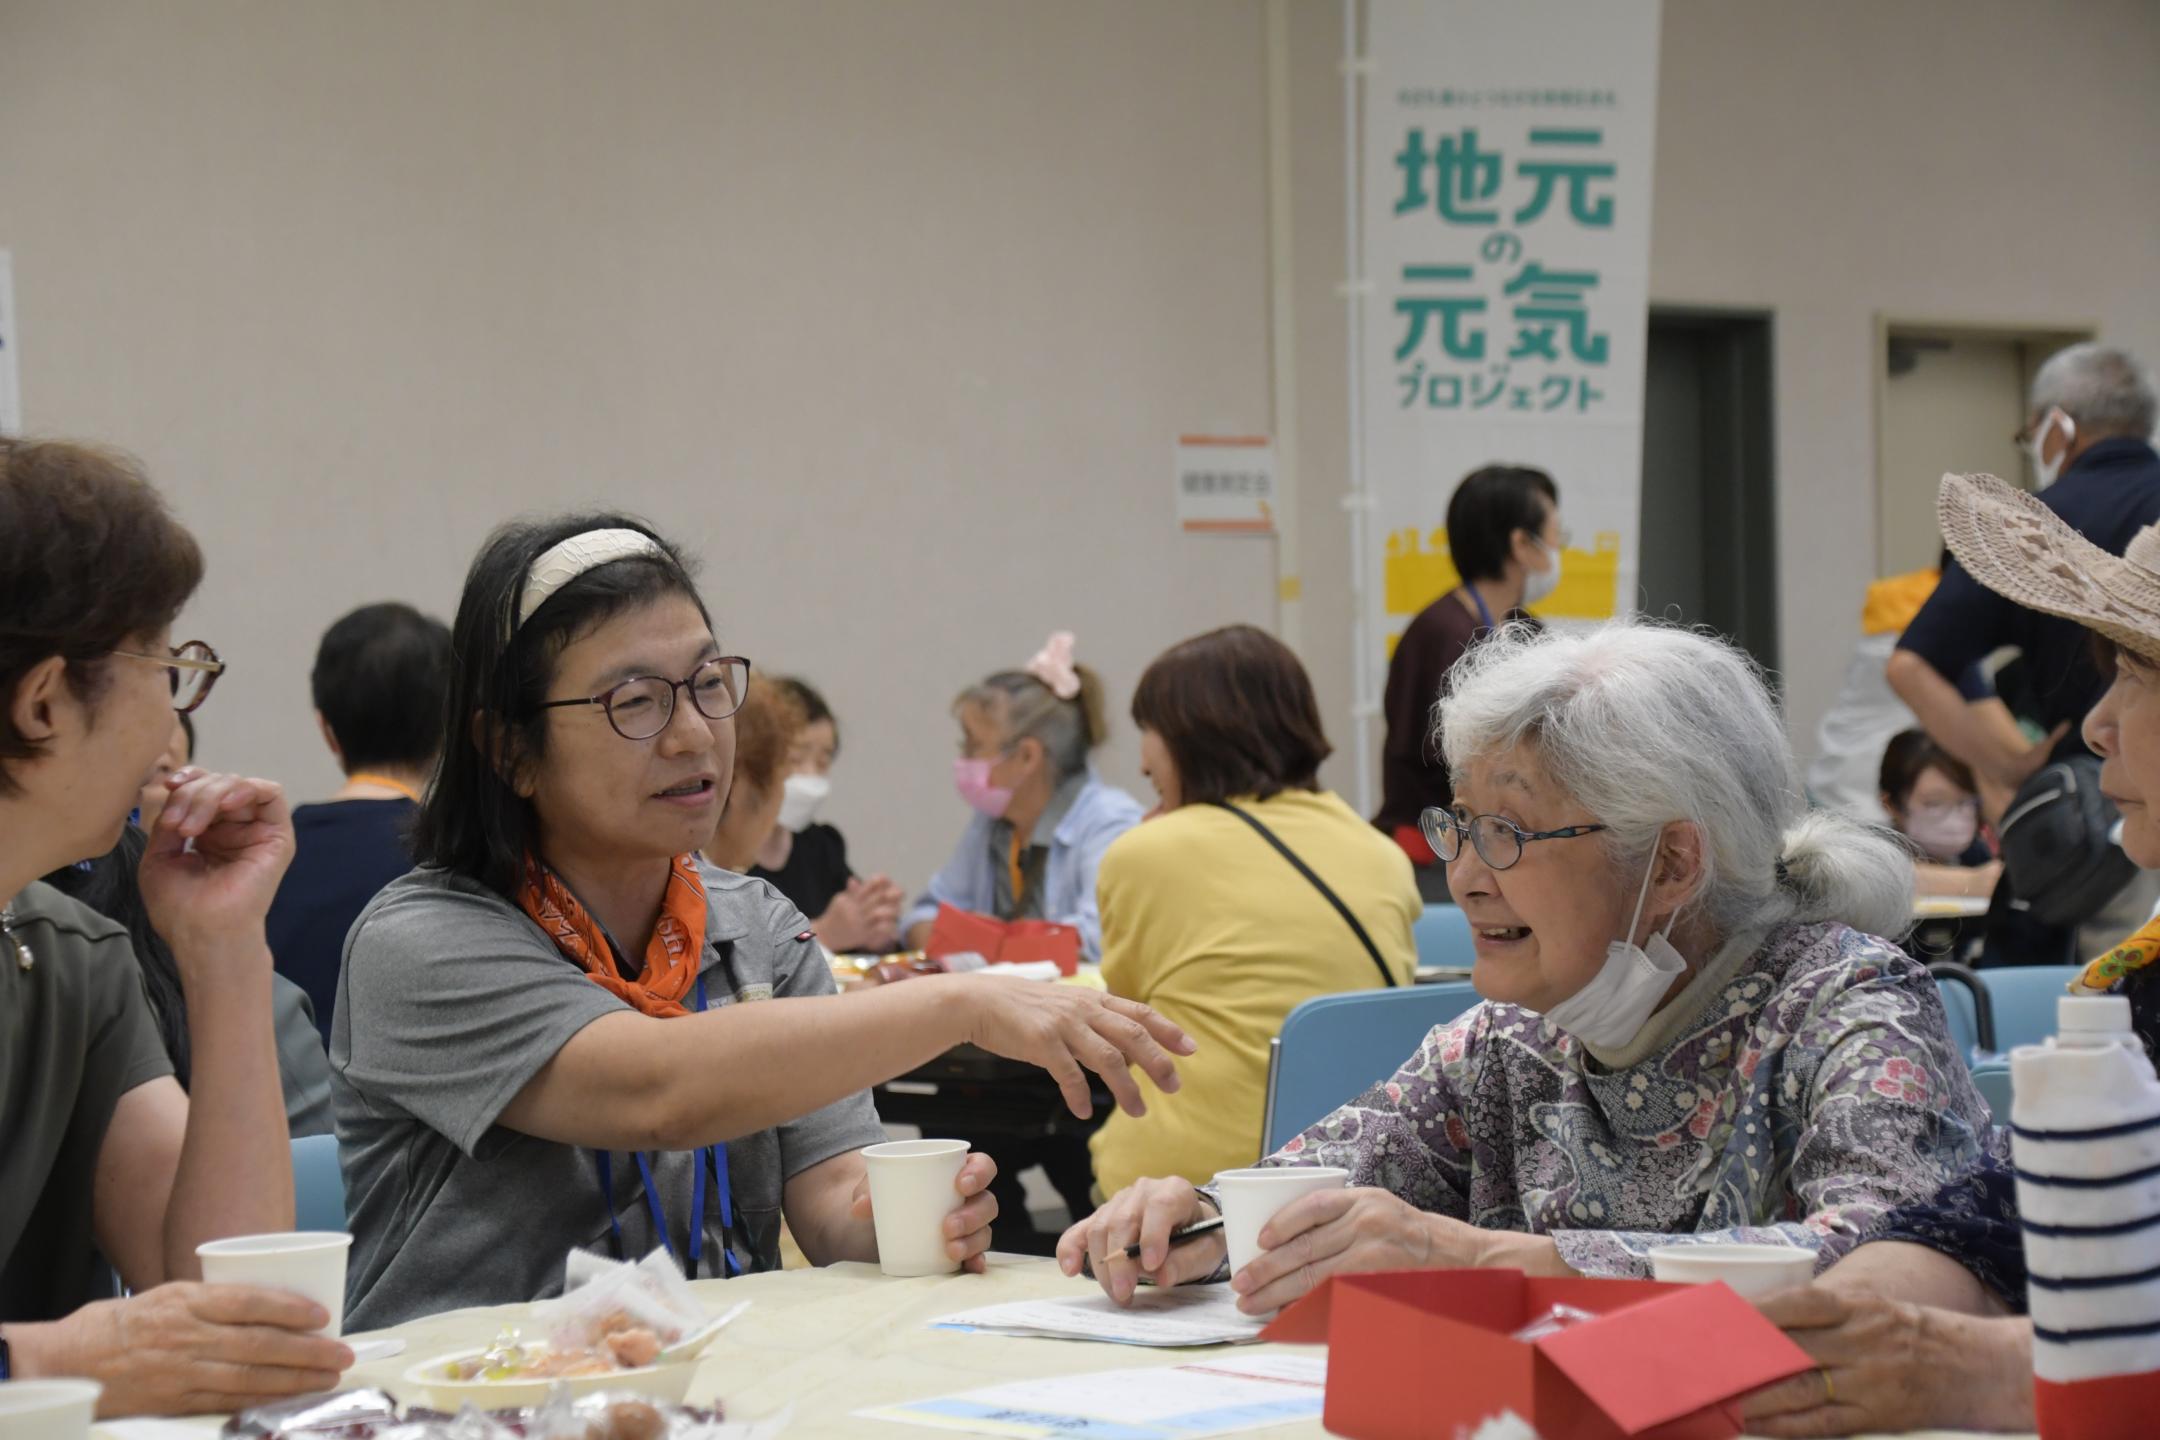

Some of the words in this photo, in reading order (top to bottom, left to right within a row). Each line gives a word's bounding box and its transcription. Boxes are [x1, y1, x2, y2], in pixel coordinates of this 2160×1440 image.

[1393, 127, 1615, 227] 地元
[1480, 231, 1523, 264] の
[1394, 262, 1611, 366] 元気
[1398, 361, 1605, 412] プロジェクト
